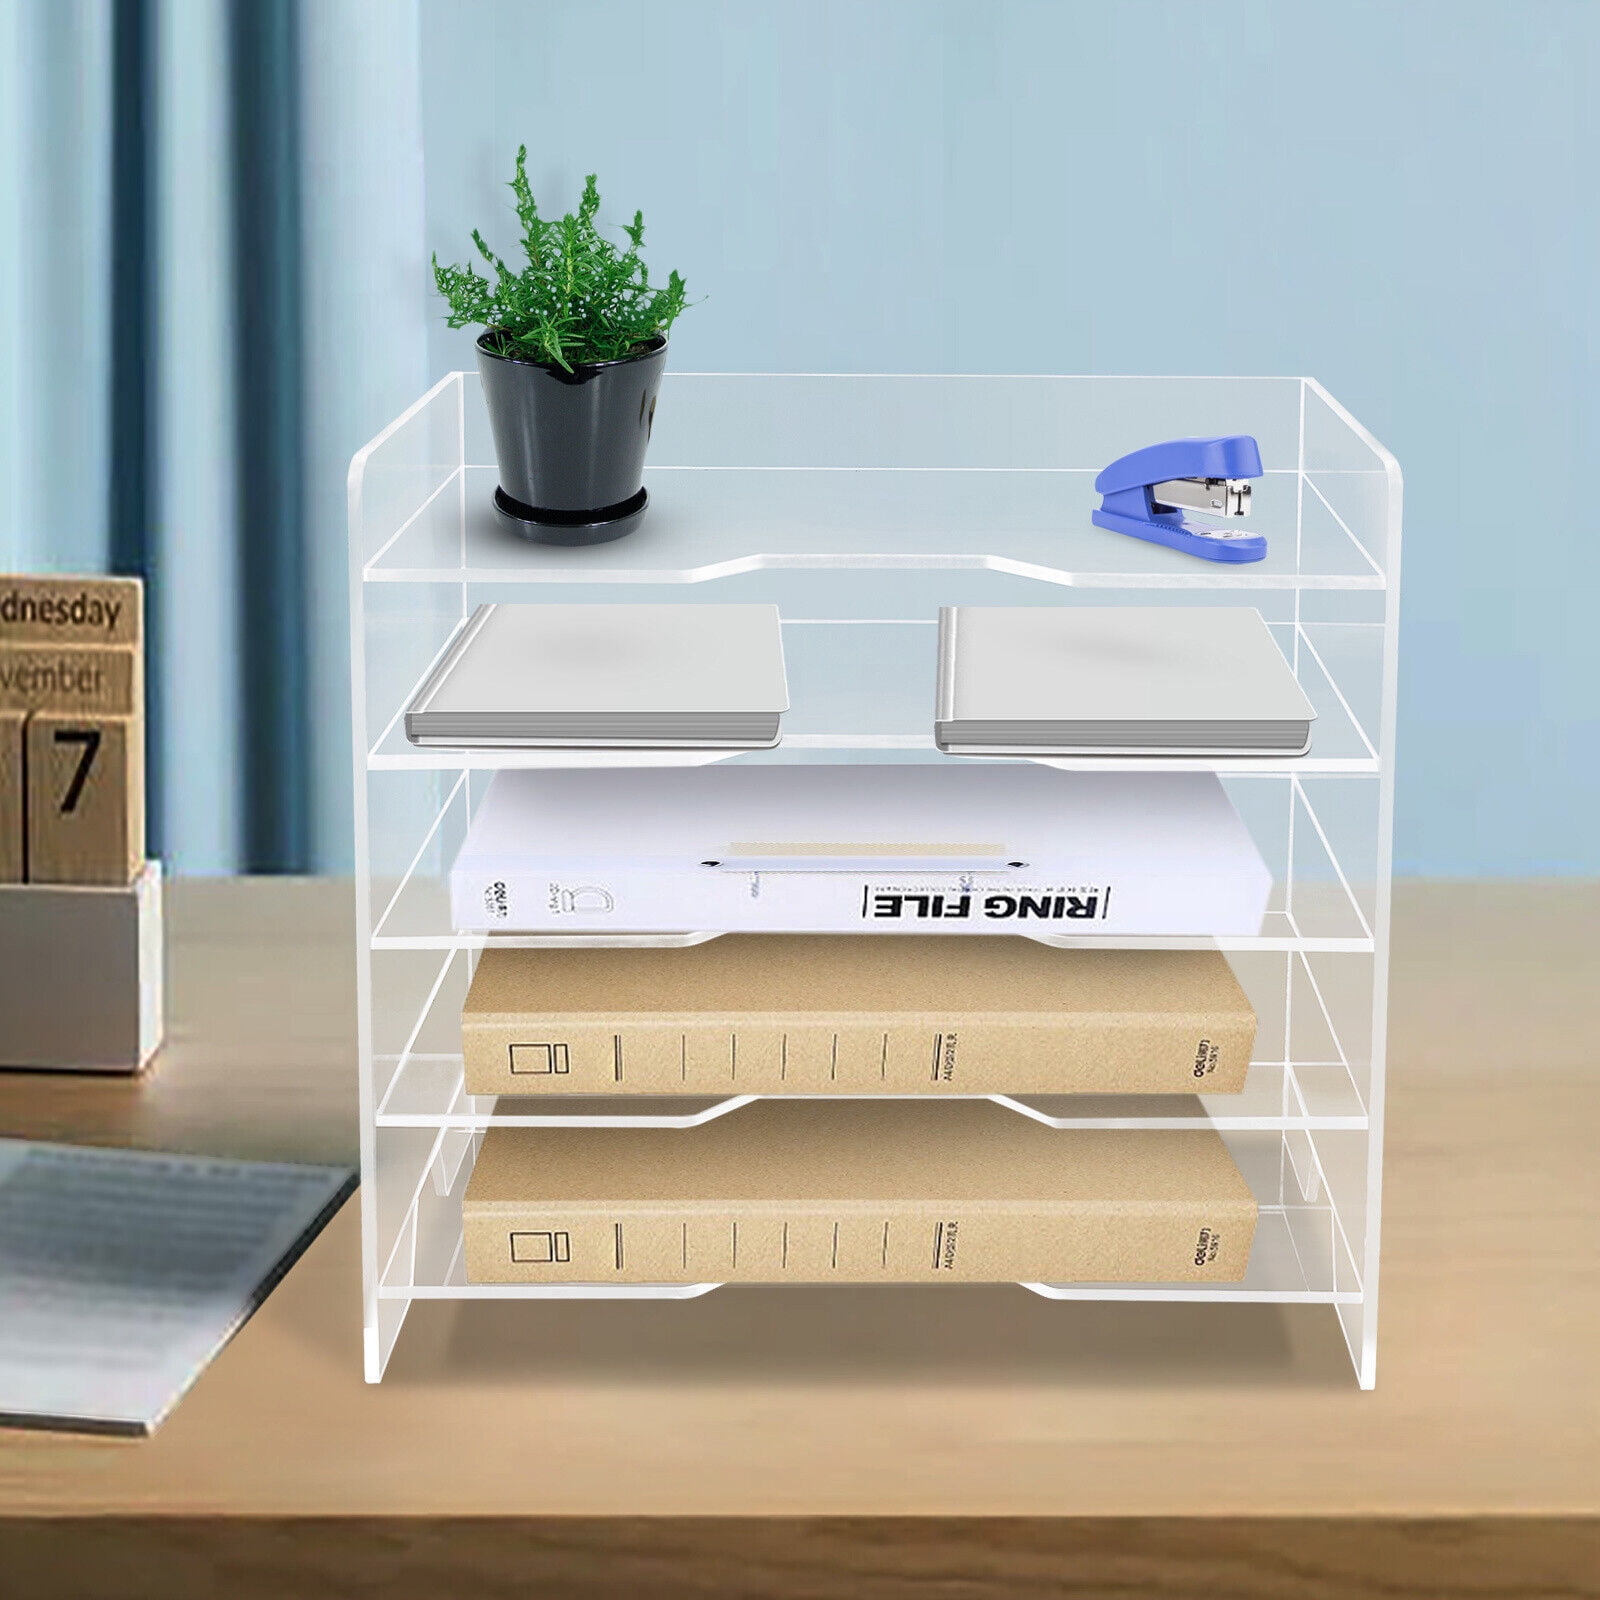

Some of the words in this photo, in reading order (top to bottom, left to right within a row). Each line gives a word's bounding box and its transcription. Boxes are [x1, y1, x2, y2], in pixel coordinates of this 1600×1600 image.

[0, 589, 122, 631] dnesday
[54, 728, 101, 813] 7
[874, 895, 971, 918] FILE
[984, 895, 1098, 919] RING
